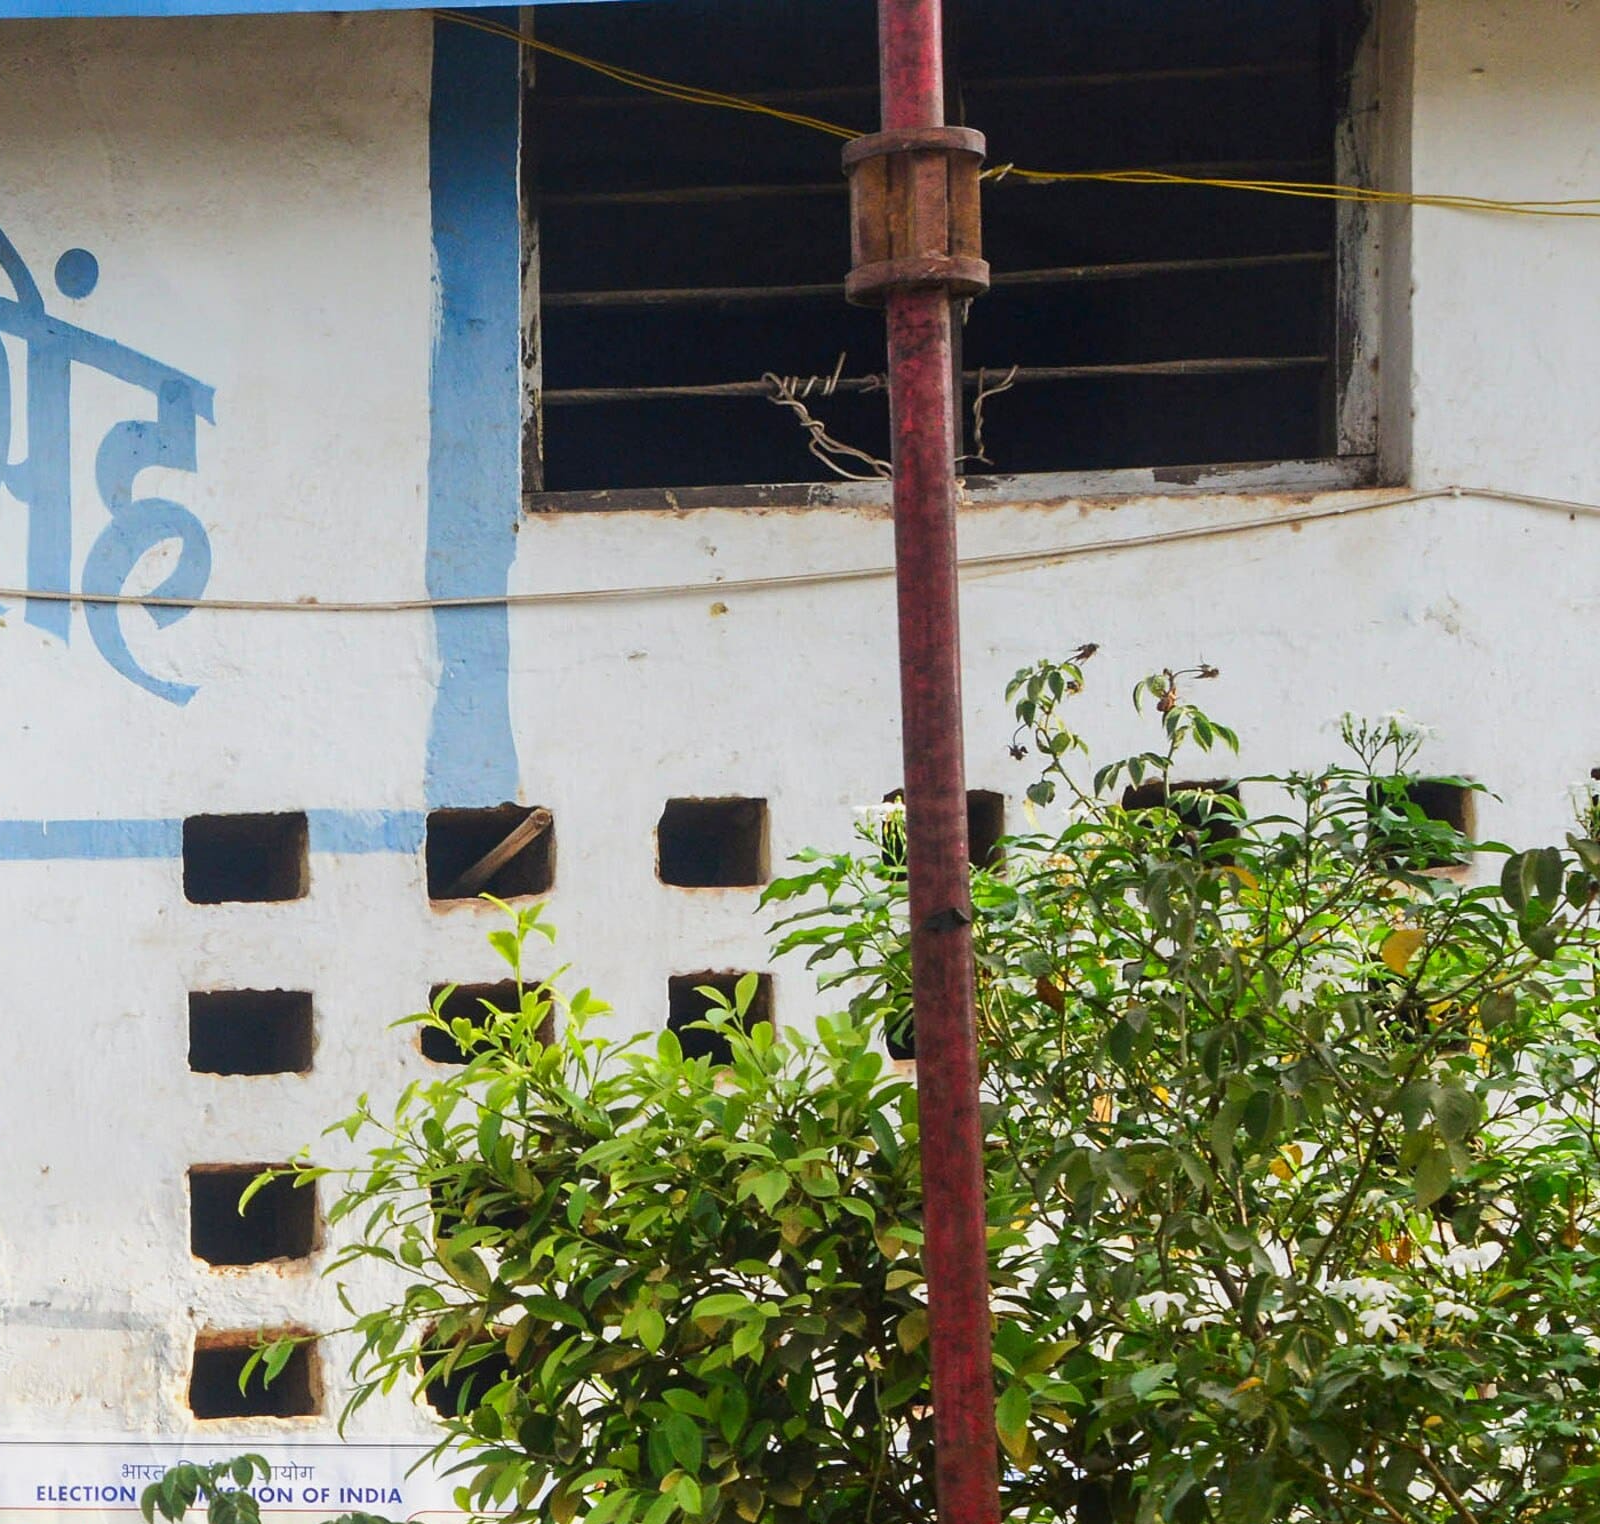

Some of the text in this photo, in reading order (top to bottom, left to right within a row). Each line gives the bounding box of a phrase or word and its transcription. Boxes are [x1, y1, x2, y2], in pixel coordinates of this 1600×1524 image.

[36, 1485, 403, 1504] ELECTION OF INDIA
